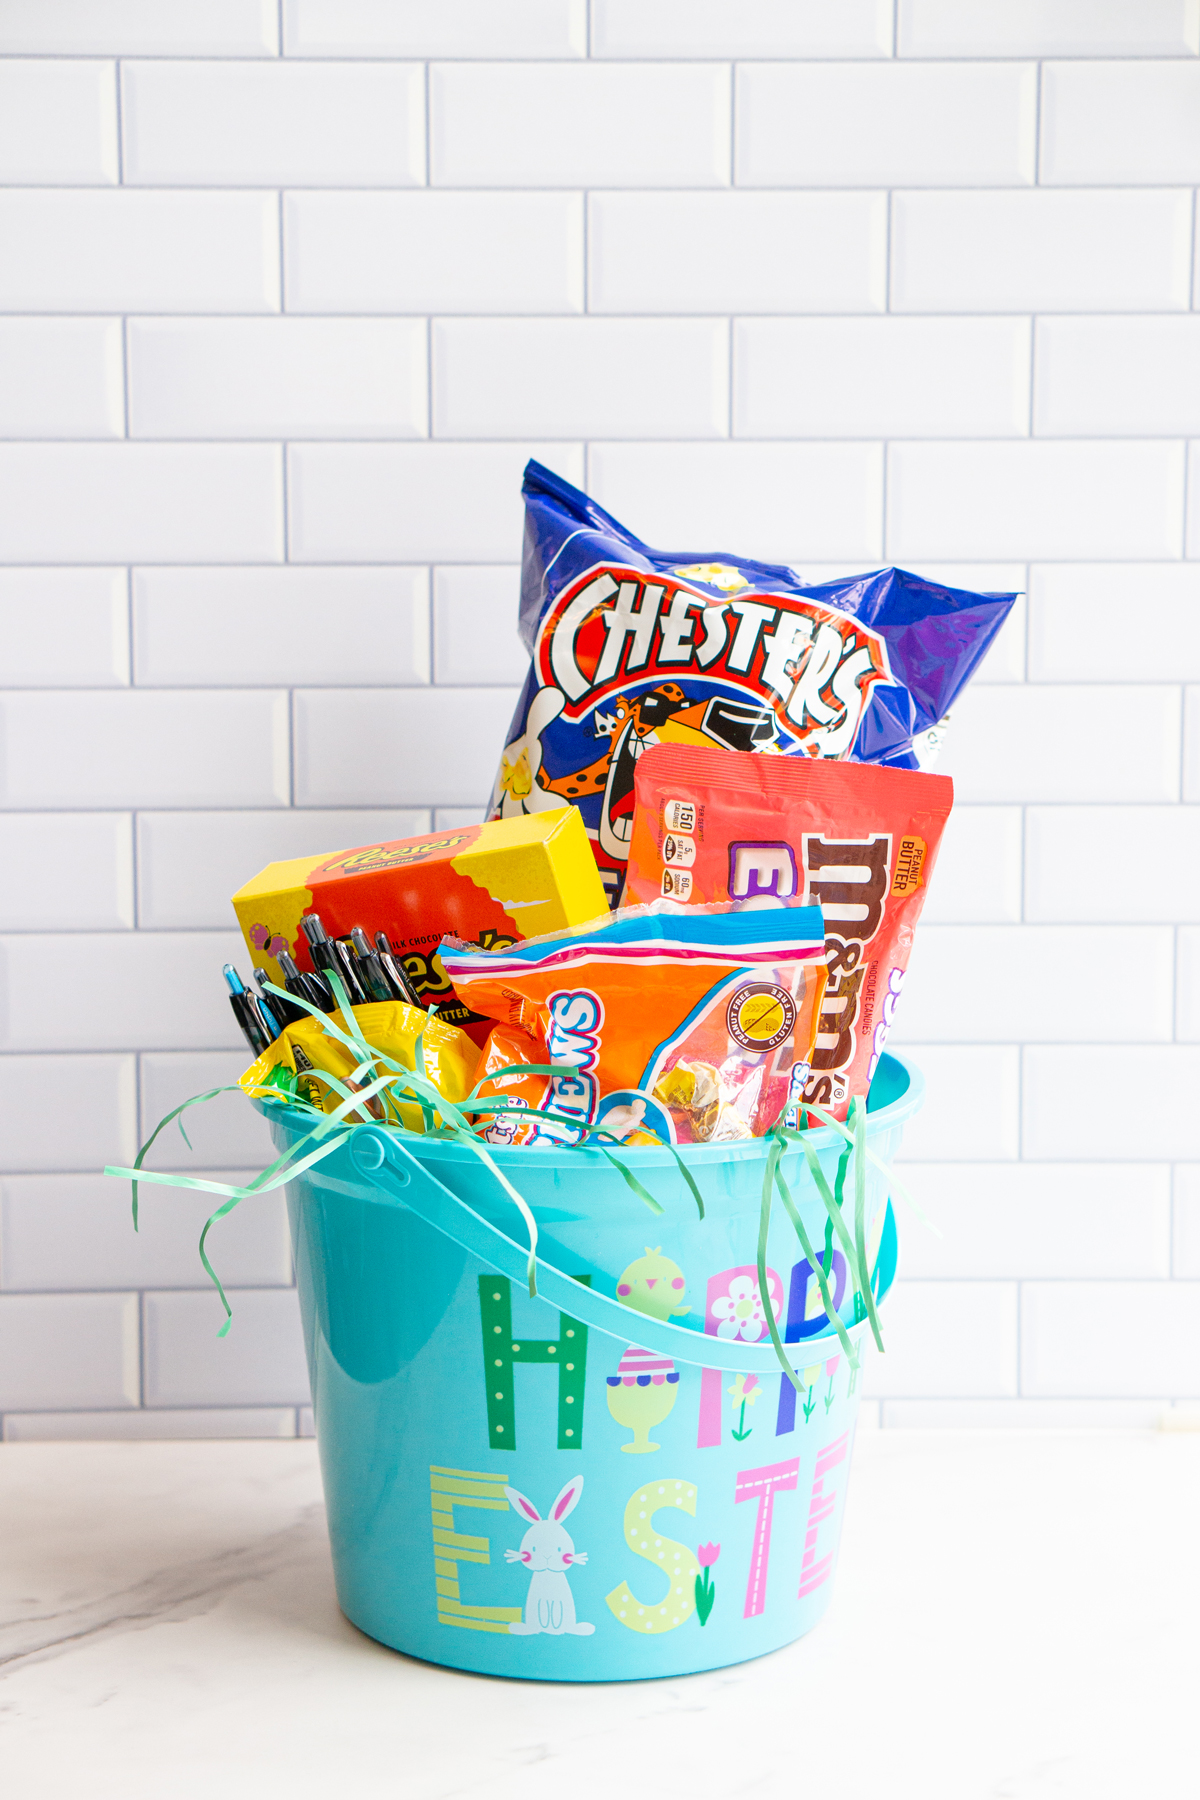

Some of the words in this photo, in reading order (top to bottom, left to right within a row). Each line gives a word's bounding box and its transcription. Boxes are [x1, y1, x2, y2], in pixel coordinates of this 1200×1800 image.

[549, 571, 877, 756] CHESTER'S
[673, 802, 681, 828] CALORIES
[679, 805, 694, 830] 150
[323, 834, 471, 873] Reese's
[676, 839, 684, 850] SAT
[676, 850, 684, 861] FAT
[358, 860, 388, 872] PEANUT
[387, 855, 414, 866] BUTTER
[893, 841, 915, 891] BUTTER
[908, 848, 924, 885] PEANUT
[673, 873, 681, 896] SODIUM
[392, 939, 407, 950] ILK
[864, 960, 879, 1002] CHOCOLATE
[732, 990, 751, 1011] FREE
[770, 987, 791, 1009] FREE
[435, 1007, 471, 1022] UTTER
[861, 1003, 875, 1036] CANDIES
[730, 1012, 750, 1045] PEANUT
[768, 1011, 793, 1046] GLUTEN
